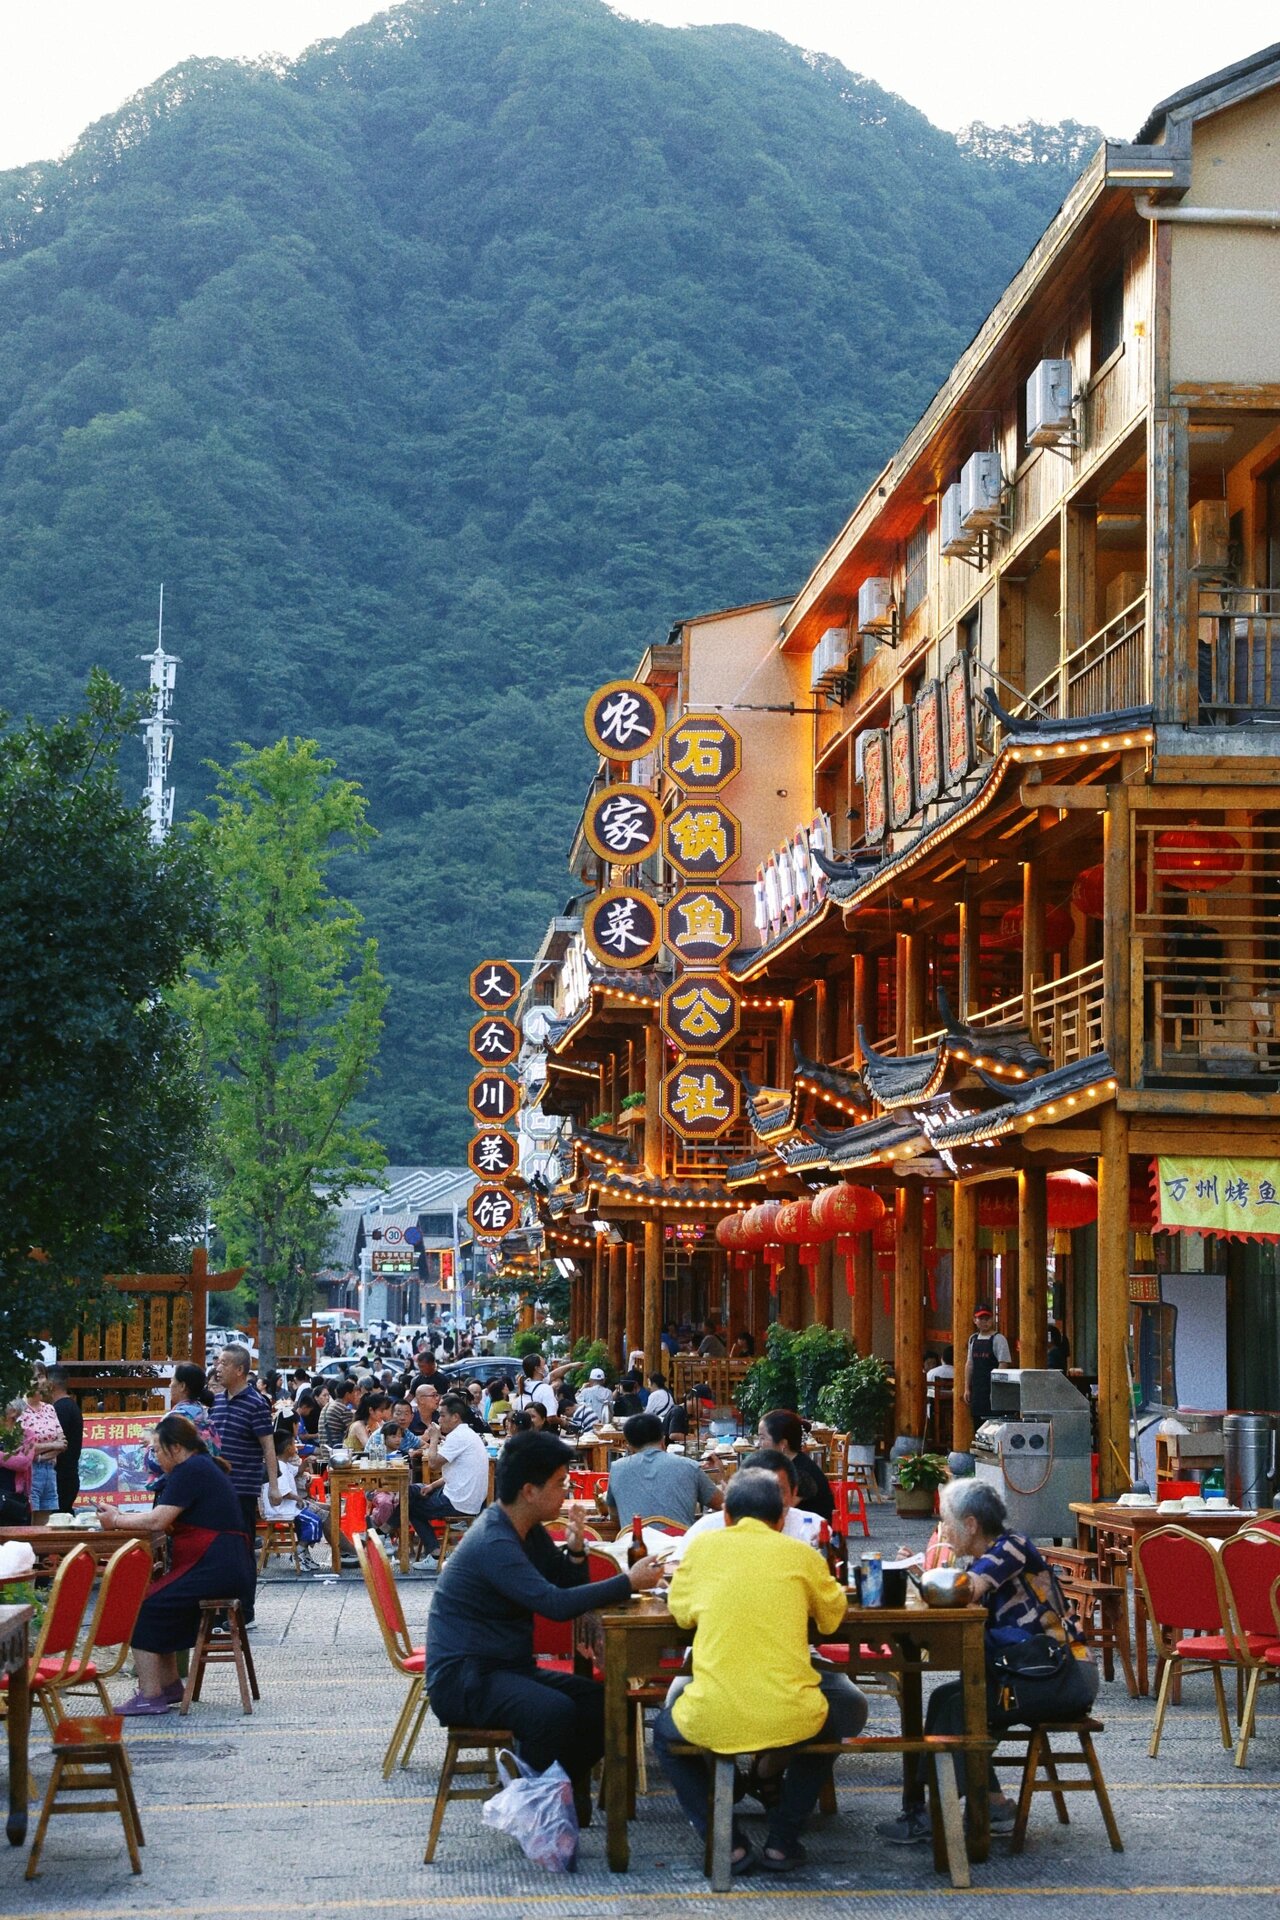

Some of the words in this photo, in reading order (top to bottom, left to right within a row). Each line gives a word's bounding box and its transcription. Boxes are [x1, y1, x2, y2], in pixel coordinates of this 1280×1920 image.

[600, 692, 651, 953] 农家菜
[671, 728, 732, 1124] 石锅鱼公社
[474, 966, 512, 1228] 大众川菜馆
[1164, 1175, 1280, 1208] 万州烤鱼
[388, 1231, 400, 1240] 30
